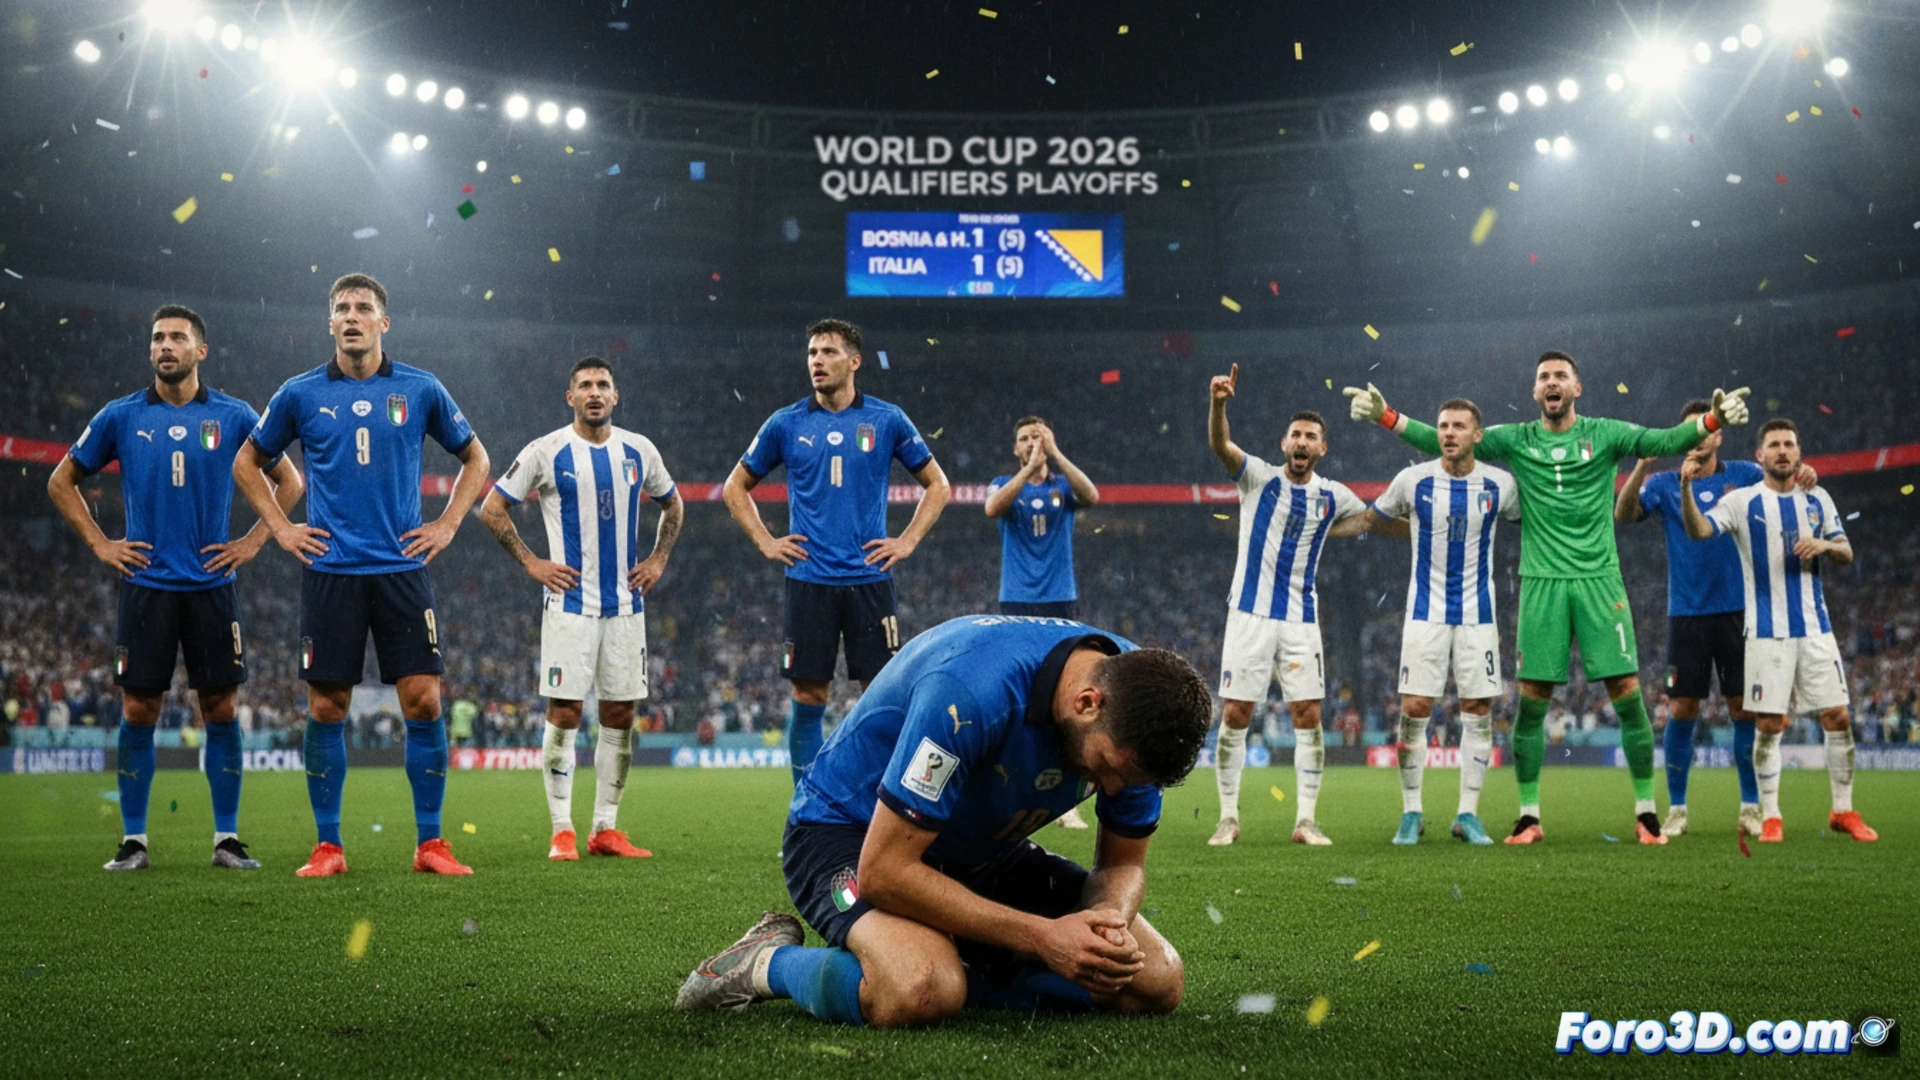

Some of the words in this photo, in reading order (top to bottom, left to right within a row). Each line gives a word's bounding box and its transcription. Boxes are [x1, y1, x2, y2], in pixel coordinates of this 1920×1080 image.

[814, 136, 953, 165] WORLD
[962, 136, 1038, 166] CUP
[1048, 136, 1140, 165] 2026
[820, 170, 1008, 201] QUALIFIERS
[1017, 172, 1158, 195] PLAYOFFS
[861, 230, 932, 248] BOSNIA
[950, 231, 970, 248] H.
[971, 227, 984, 248] 1
[868, 256, 927, 275] ITALIA
[971, 254, 984, 276] 1
[355, 427, 370, 465] 9
[231, 621, 242, 655] 9
[423, 608, 438, 644] 9
[1615, 622, 1627, 652] 1
[1485, 650, 1495, 676] 3
